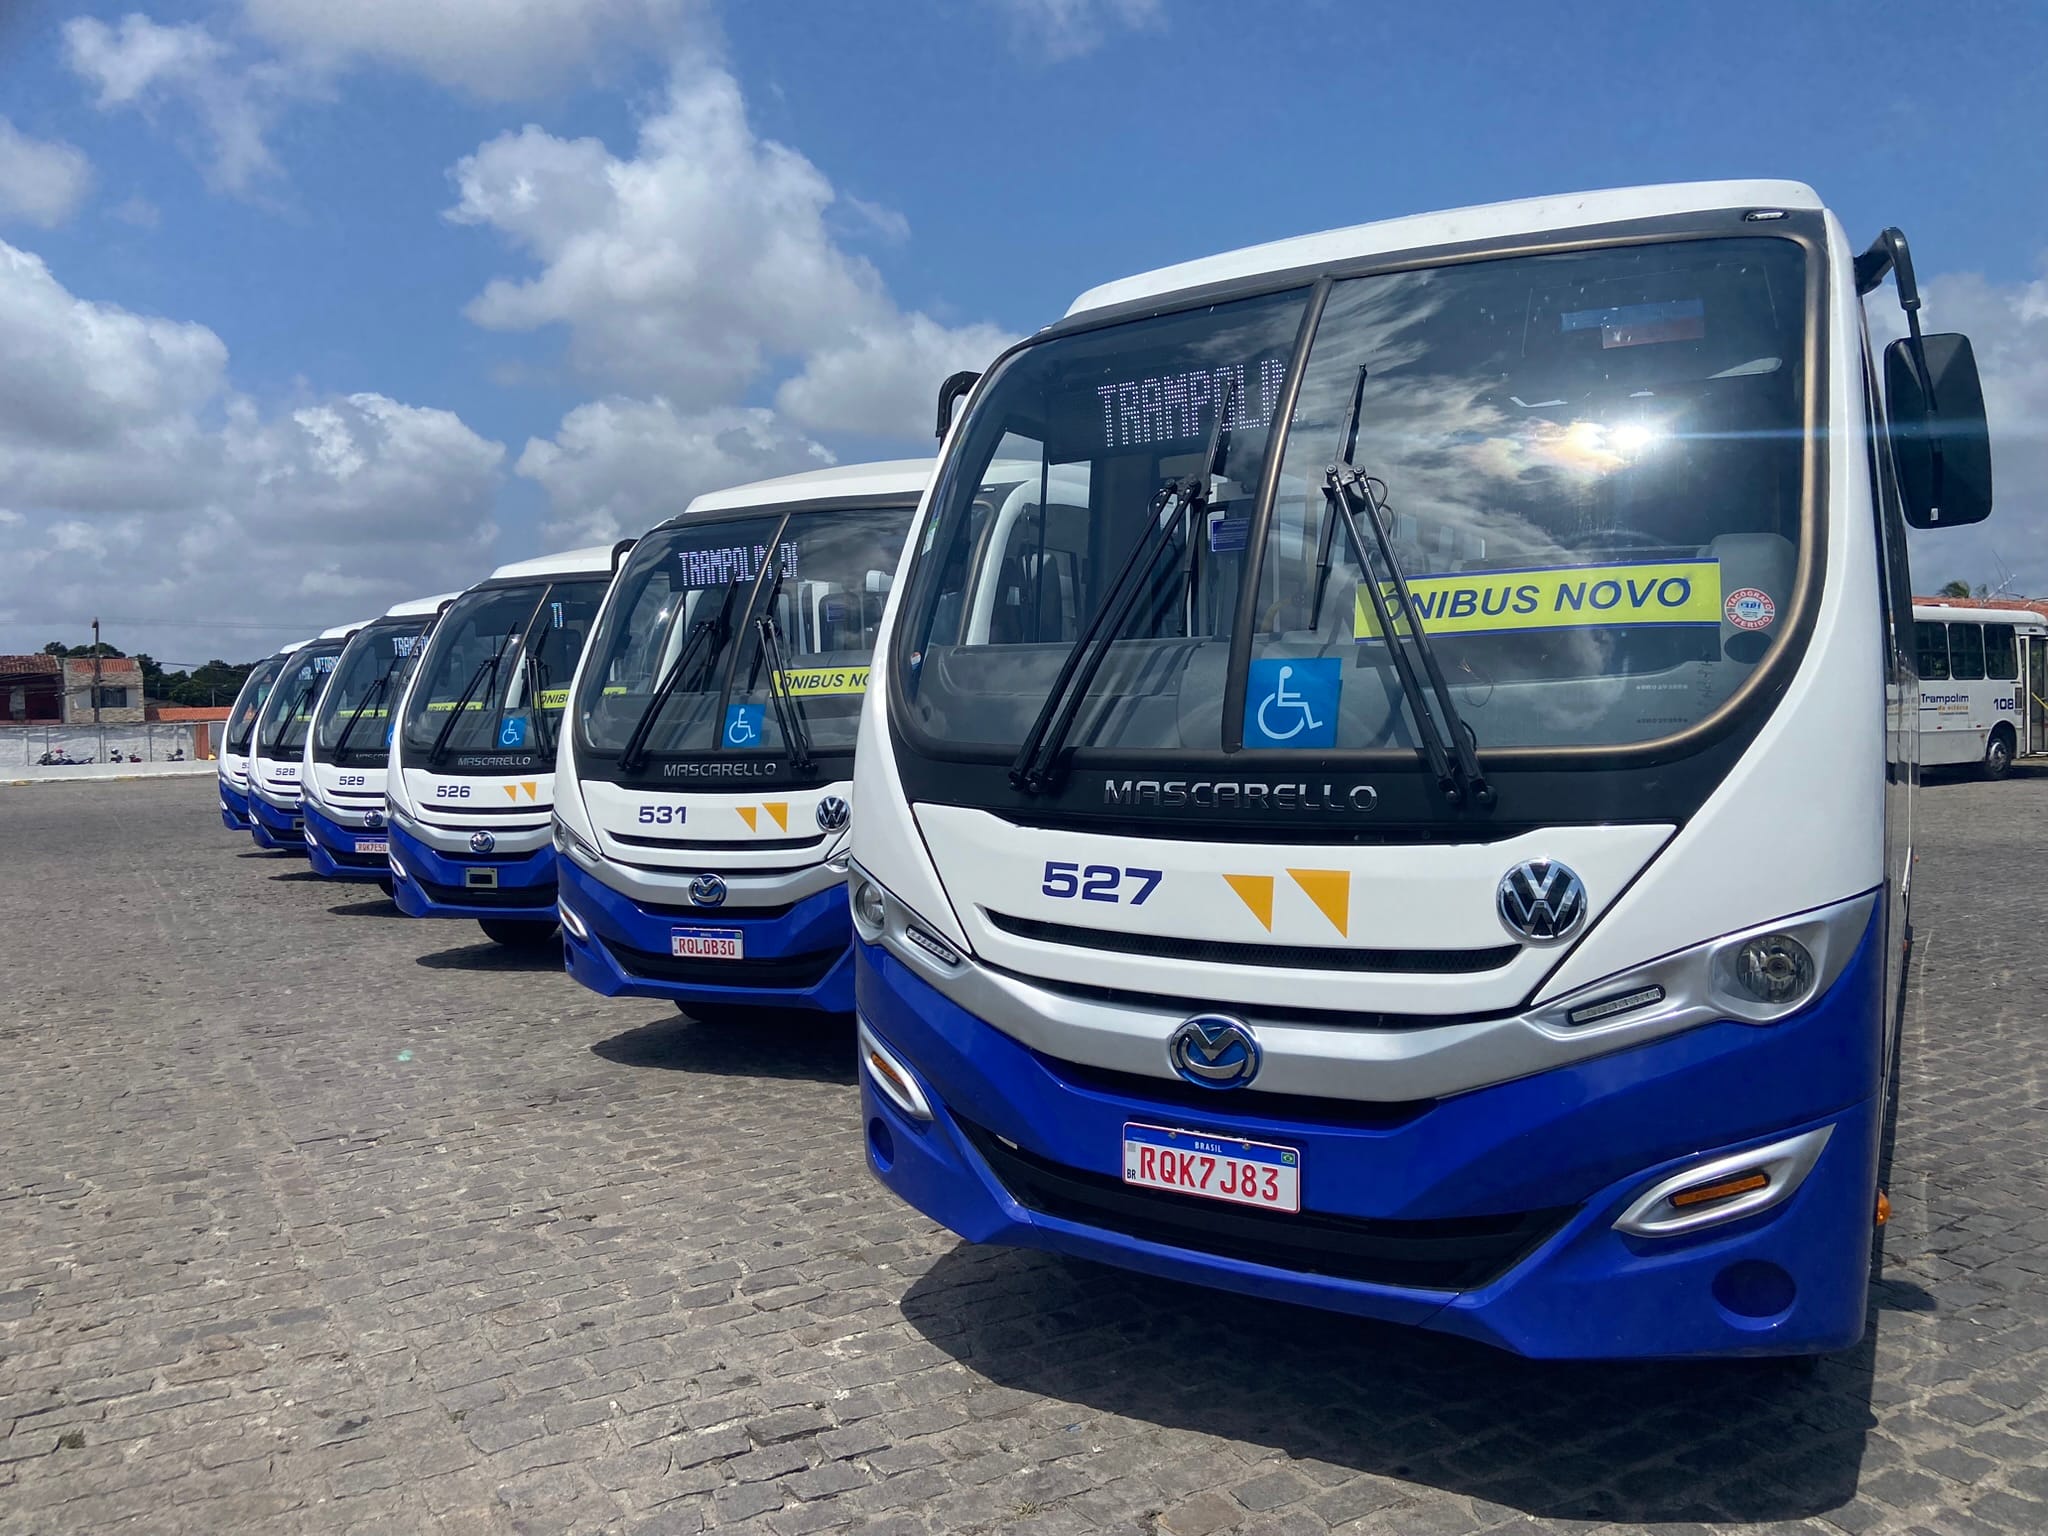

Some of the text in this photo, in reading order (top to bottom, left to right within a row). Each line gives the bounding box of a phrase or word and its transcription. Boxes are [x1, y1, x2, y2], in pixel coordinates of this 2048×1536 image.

[1554, 577, 1691, 612] NOVO
[1728, 590, 1772, 610] TACOGRAFO
[1729, 614, 1770, 628] AFERIDO
[780, 673, 845, 690] ÔNIBUS
[1921, 693, 1969, 705] Trampolim
[1993, 698, 2014, 710] 108
[457, 756, 532, 766] MASCARELLO
[275, 768, 296, 776] 528
[663, 763, 777, 777] MASCARELLO
[339, 776, 365, 786] 529
[436, 785, 471, 798] 526
[1104, 779, 1378, 812] MASCARELLO
[638, 806, 687, 824] 531
[1041, 861, 1163, 906] 527
[1194, 1141, 1223, 1153] BRASIL
[1126, 1168, 1136, 1180] BR
[1140, 1146, 1279, 1201] RQK7J83
